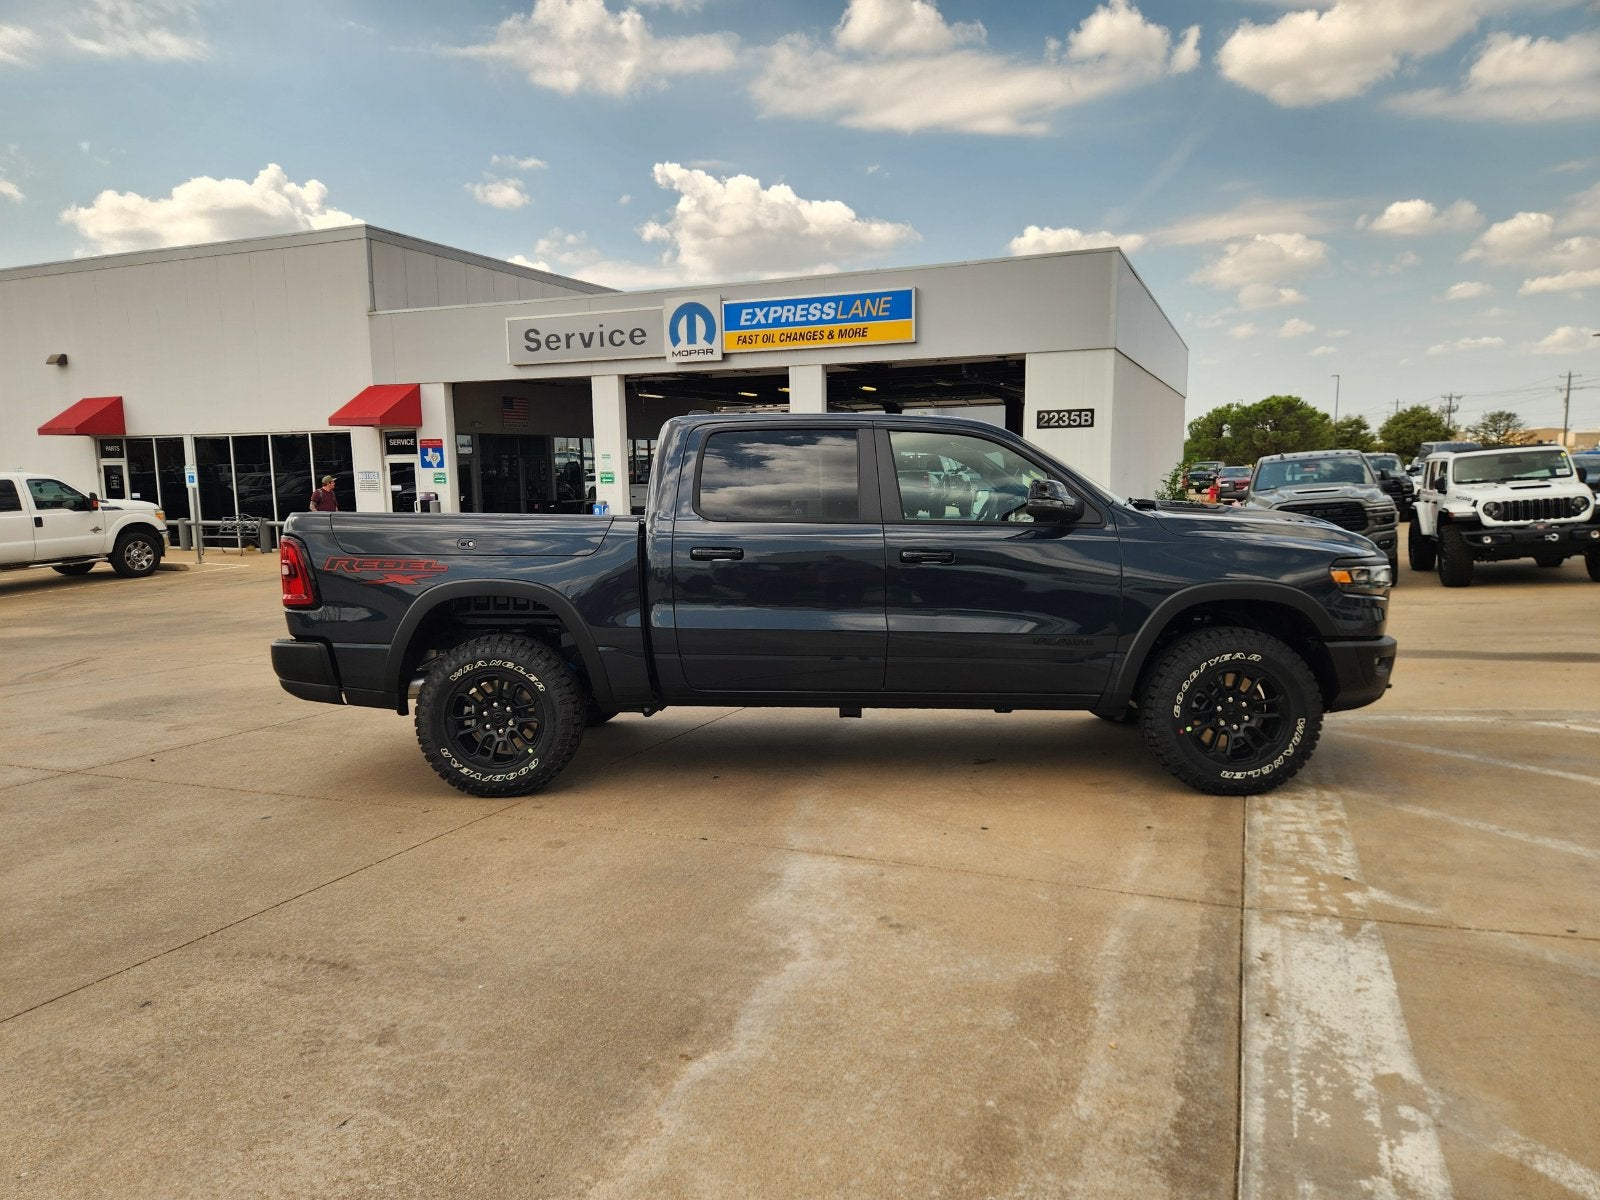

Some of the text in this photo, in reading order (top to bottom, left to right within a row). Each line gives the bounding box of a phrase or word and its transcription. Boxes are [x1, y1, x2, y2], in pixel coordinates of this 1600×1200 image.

[524, 324, 647, 353] Service
[736, 327, 869, 345] FAST OIL CHANGES & MORE
[671, 348, 714, 358] MOPAR
[1039, 411, 1092, 427] 2235B
[388, 438, 415, 446] SERVICE
[323, 556, 449, 573] REBEL
[449, 659, 546, 693] WRANGLER
[1173, 652, 1262, 719] GOODYEAR
[1220, 717, 1306, 780] WRANGLER
[440, 747, 539, 782] GOODYEAR
